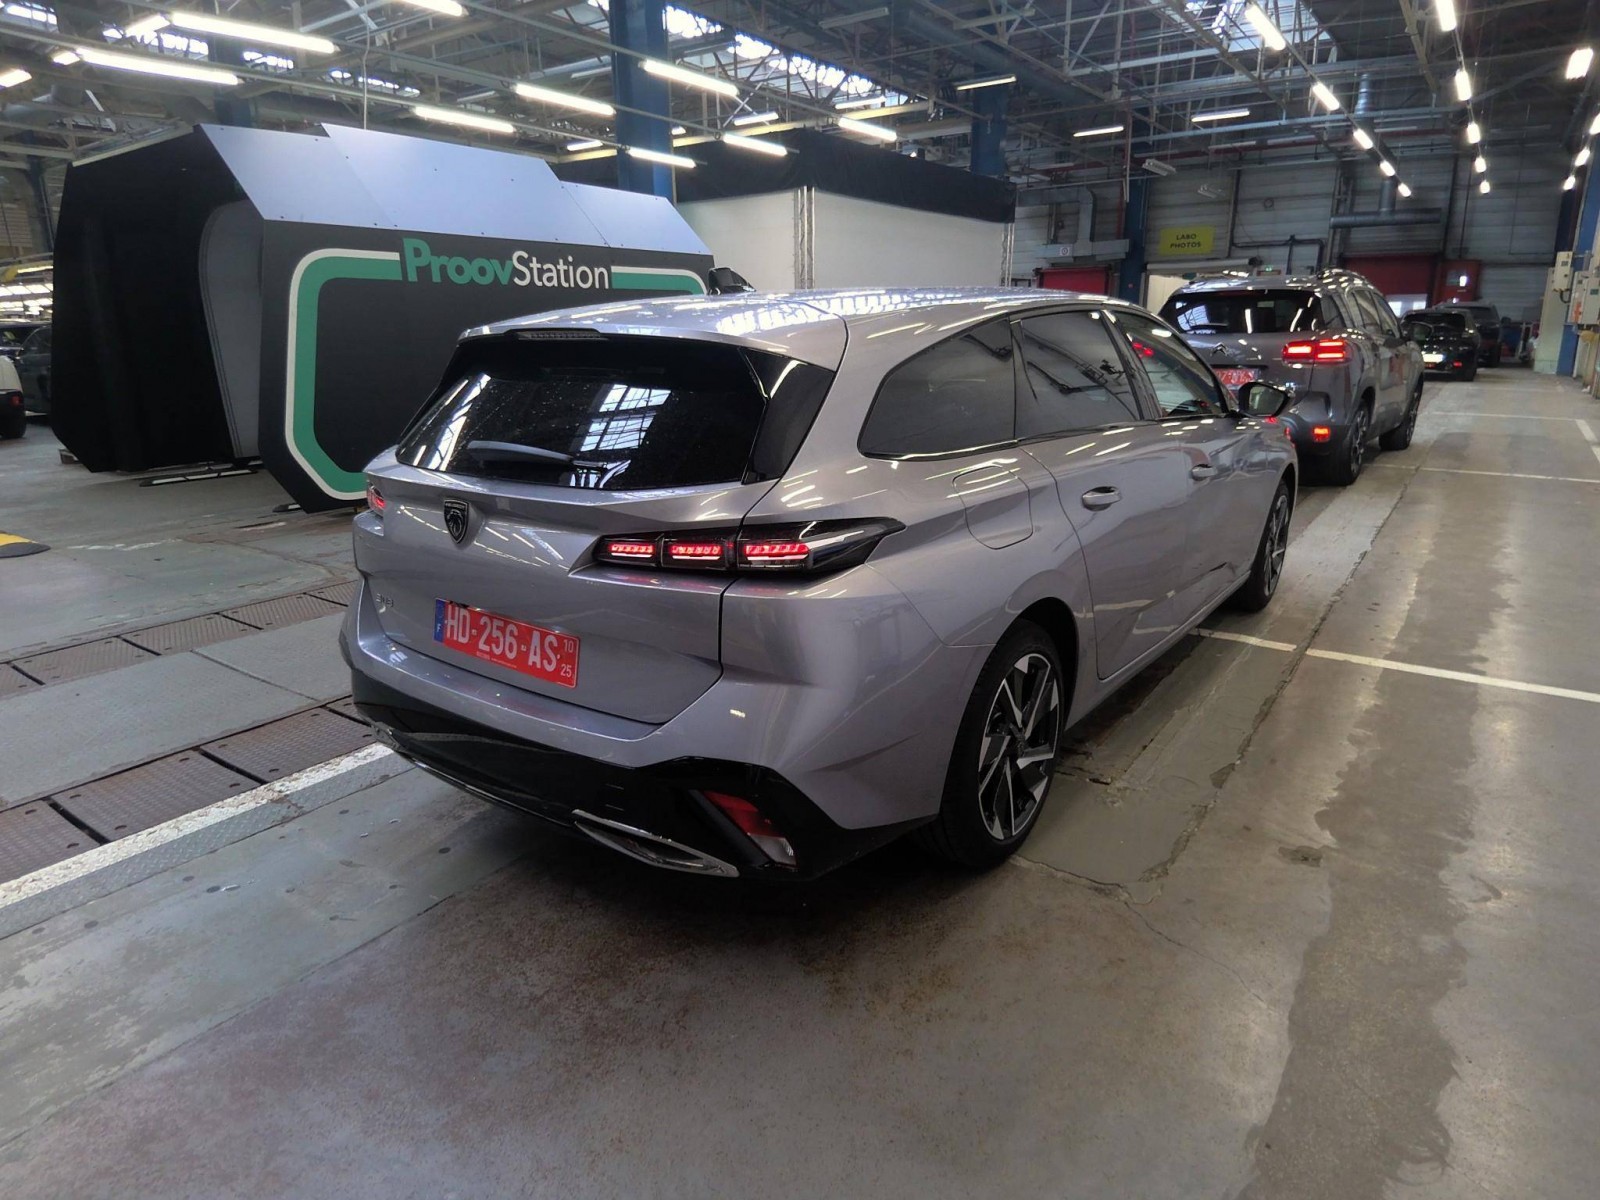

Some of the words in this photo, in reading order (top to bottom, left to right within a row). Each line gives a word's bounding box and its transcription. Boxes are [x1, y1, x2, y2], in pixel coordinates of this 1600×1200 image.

[1176, 233, 1197, 241] LABO
[1170, 241, 1201, 249] PHOTOS
[403, 238, 610, 290] ProovStation
[436, 623, 442, 632] F
[446, 603, 559, 673] HD-256-AS
[563, 639, 575, 653] 10
[560, 663, 573, 678] 25
